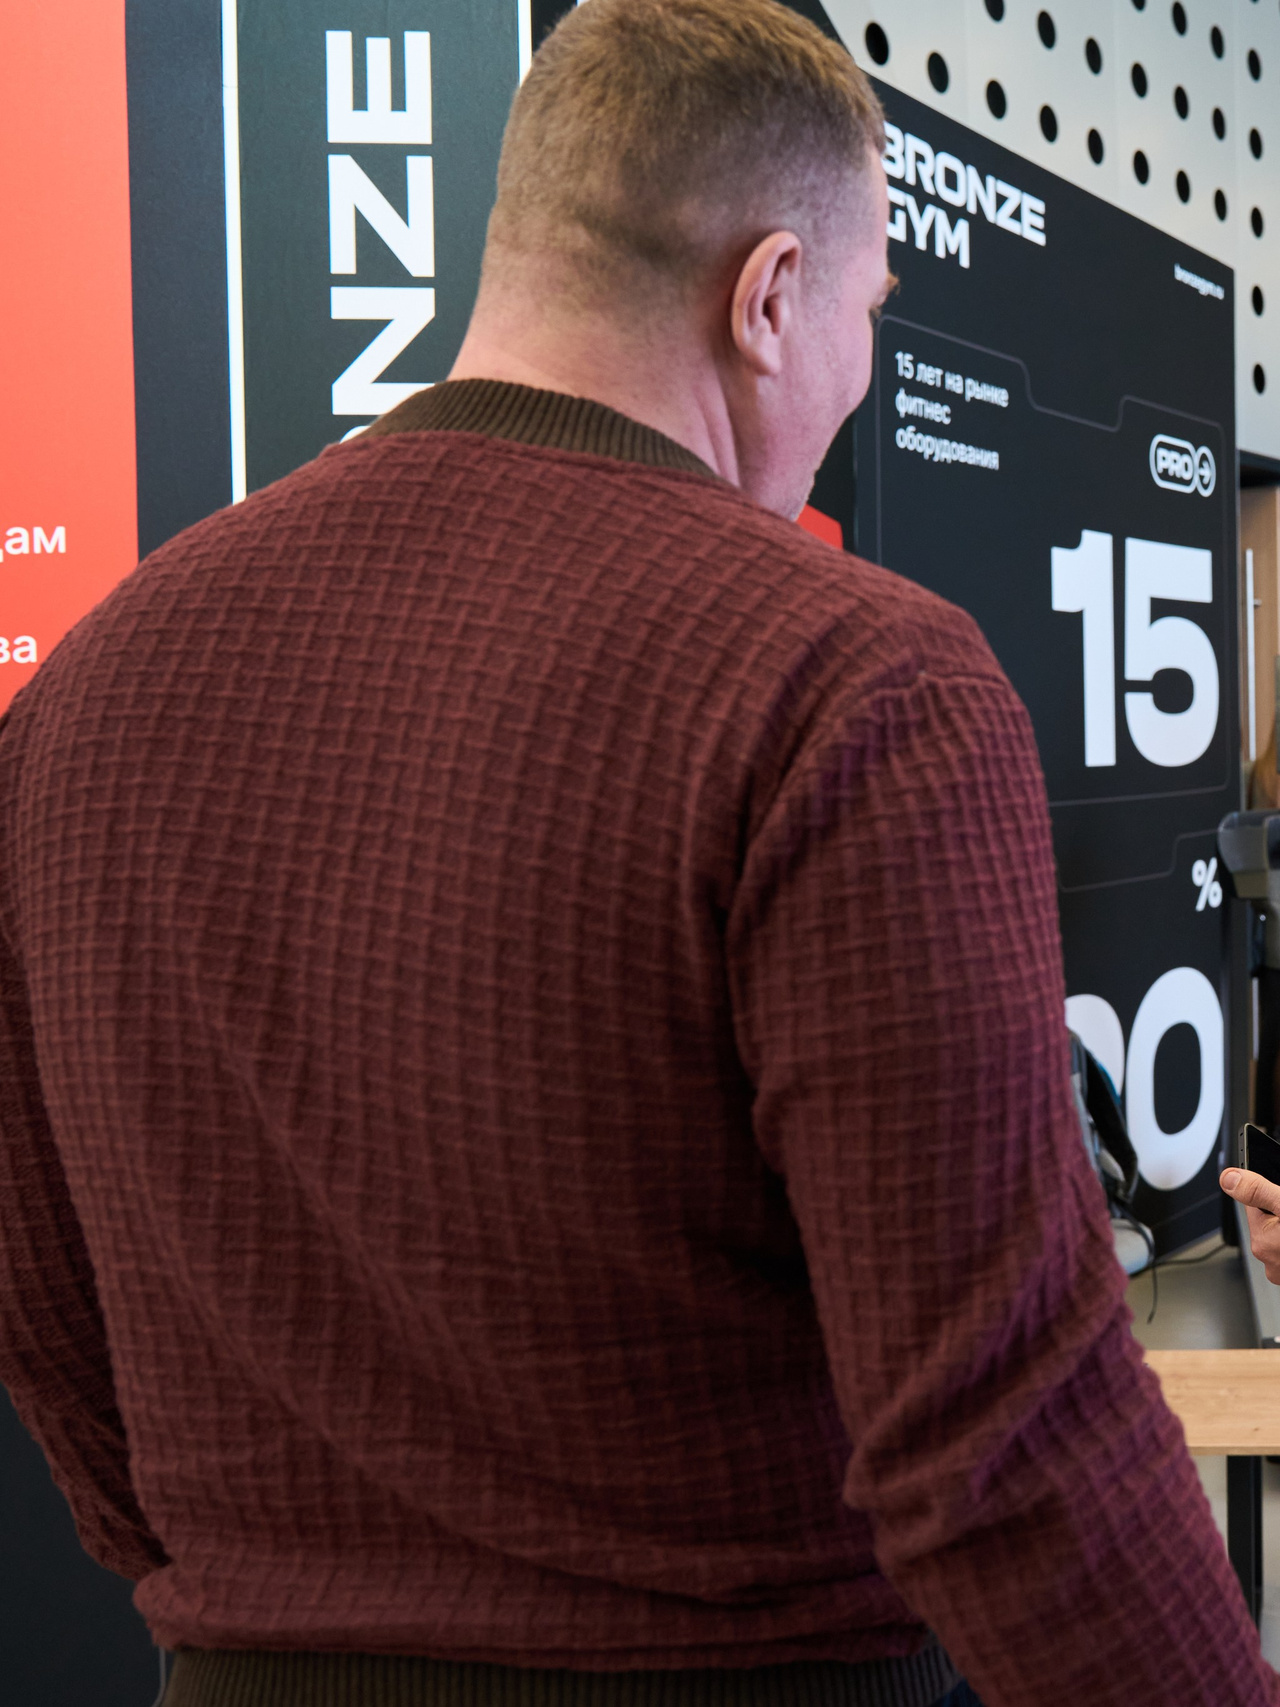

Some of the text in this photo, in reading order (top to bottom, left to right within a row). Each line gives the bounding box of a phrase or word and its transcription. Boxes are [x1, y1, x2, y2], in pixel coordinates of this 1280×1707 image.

[881, 120, 1047, 247] BRONZE
[326, 30, 435, 444] NZE
[895, 350, 1010, 408] 15 лет на рынке
[895, 387, 952, 425] фитнес
[895, 424, 1000, 471] оборудования
[1156, 447, 1195, 481] PRO
[1051, 528, 1220, 768] 15
[1064, 966, 1225, 1191] 0
